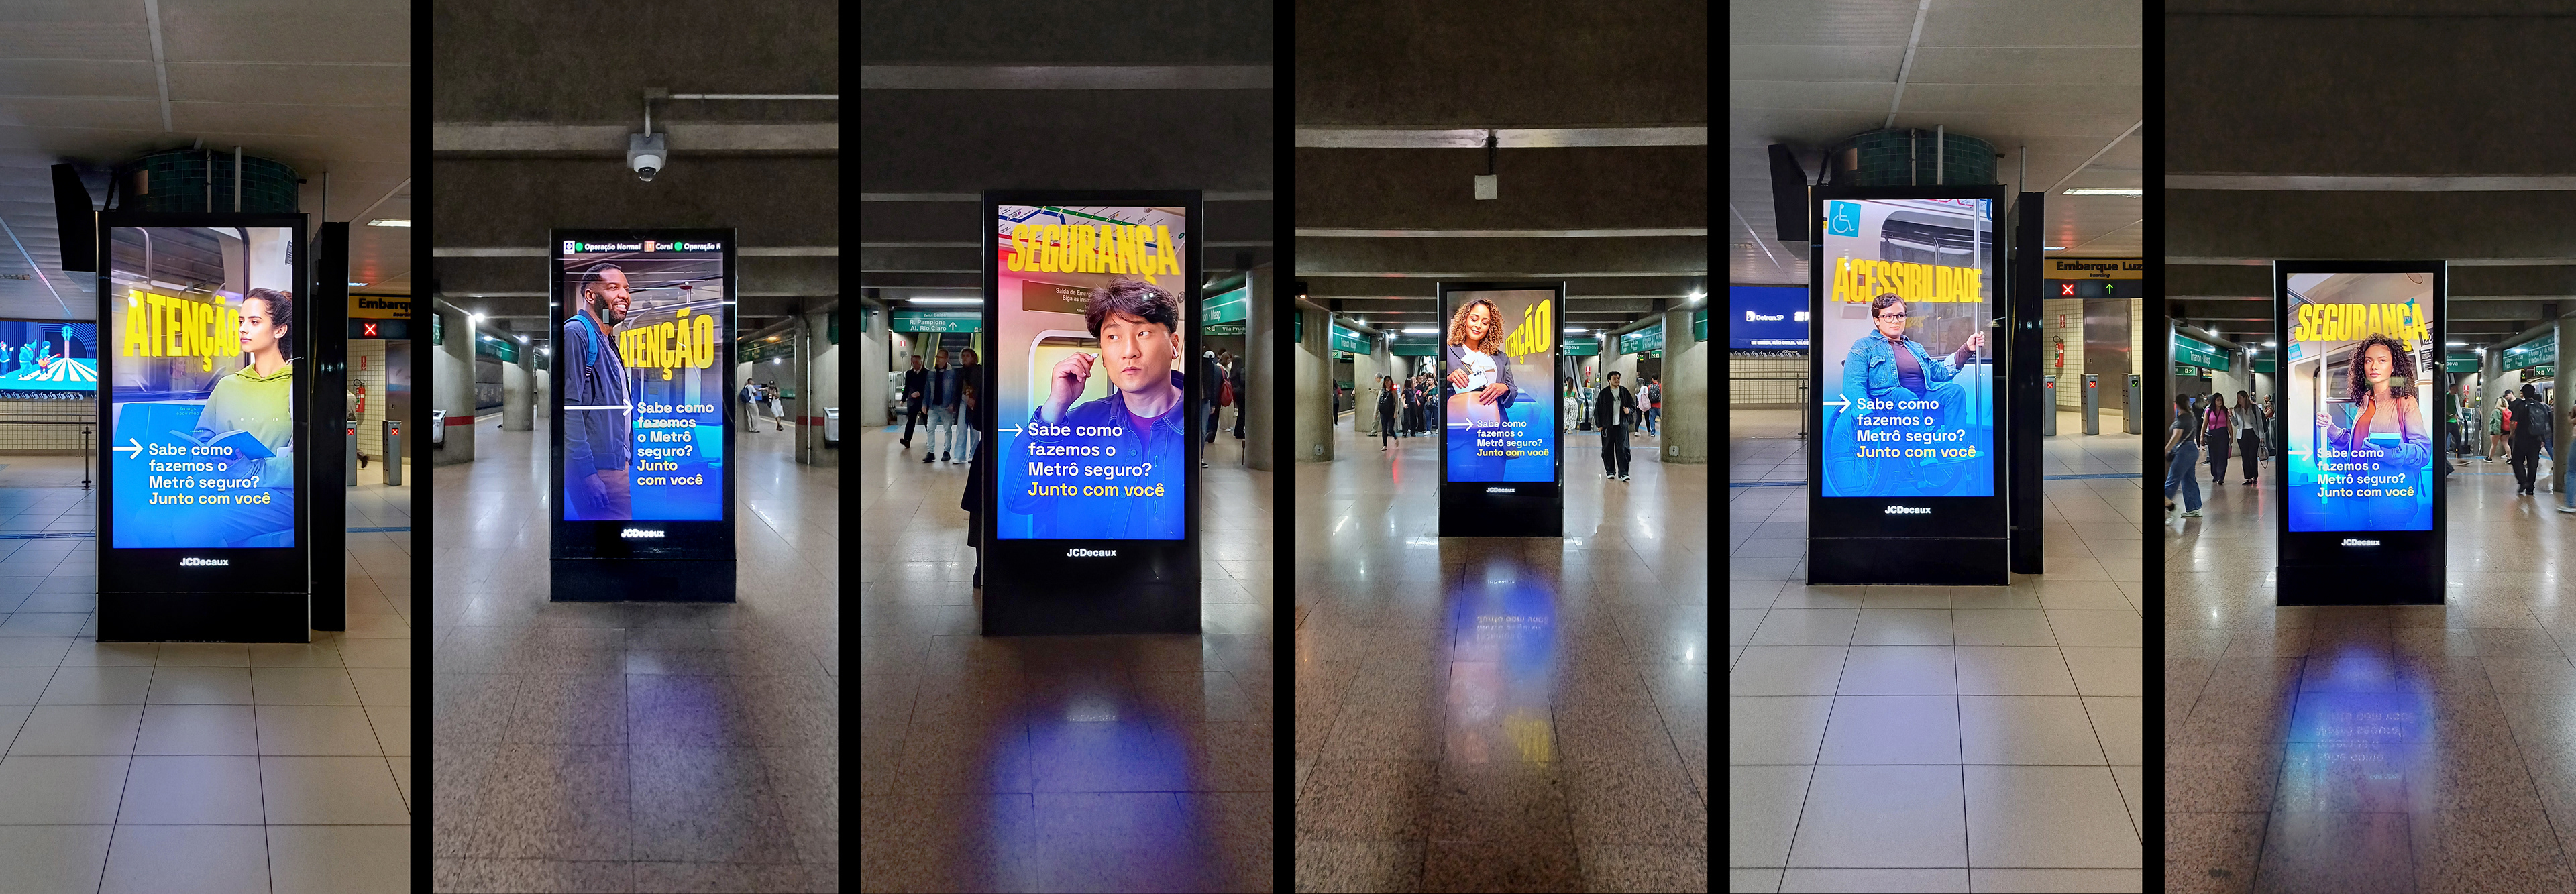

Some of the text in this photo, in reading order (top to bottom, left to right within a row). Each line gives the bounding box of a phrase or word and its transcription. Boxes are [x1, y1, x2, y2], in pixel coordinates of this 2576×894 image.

[584, 243, 616, 252] Operação
[684, 243, 715, 252] Operação
[1008, 223, 1181, 285] SEGURANÇA
[2057, 260, 2143, 273] Embarque Luz
[1831, 258, 1983, 302] ACESSIBILIDADE
[1210, 309, 1221, 321] Masp
[123, 290, 240, 372] ATENÇÃO
[1505, 299, 1551, 364] ATENÇÃO
[2295, 303, 2430, 352] SEGURANÇA
[619, 306, 714, 381] ATENÇÃO
[637, 402, 714, 413] Sabe como
[1857, 398, 1939, 410] Sabe como
[637, 416, 696, 428] fazemos
[1857, 414, 1933, 426] fazemos o
[1028, 422, 1122, 436] Sabe como
[637, 431, 692, 442] o Metrô
[1857, 429, 1966, 445] Metrô seguro?
[149, 443, 233, 456] Sabe como
[1028, 442, 1116, 456] fazemos o
[1477, 439, 1543, 448] Metrô seguro?
[637, 445, 693, 459] seguro?
[1527, 448, 1549, 456] você
[1856, 445, 1976, 457] Junto com você
[2317, 448, 2347, 457] Sabe
[149, 459, 227, 472] fazemos o
[637, 460, 678, 471] Junto
[1028, 462, 1152, 480] Metrô seguro?
[2317, 461, 2369, 471] fazemos
[149, 476, 260, 491] Metrô seguro?
[637, 473, 703, 485] com você
[2317, 473, 2406, 486] Metrô seguro?
[1028, 482, 1165, 496] Junto com você
[2317, 486, 2414, 497] Junto com você
[149, 492, 271, 504] Junto com você
[1884, 506, 1931, 514] JCDecaux
[621, 528, 665, 537] JCDecaux
[1067, 548, 1117, 557] JCDecaux
[180, 557, 229, 566] JCDecaux
